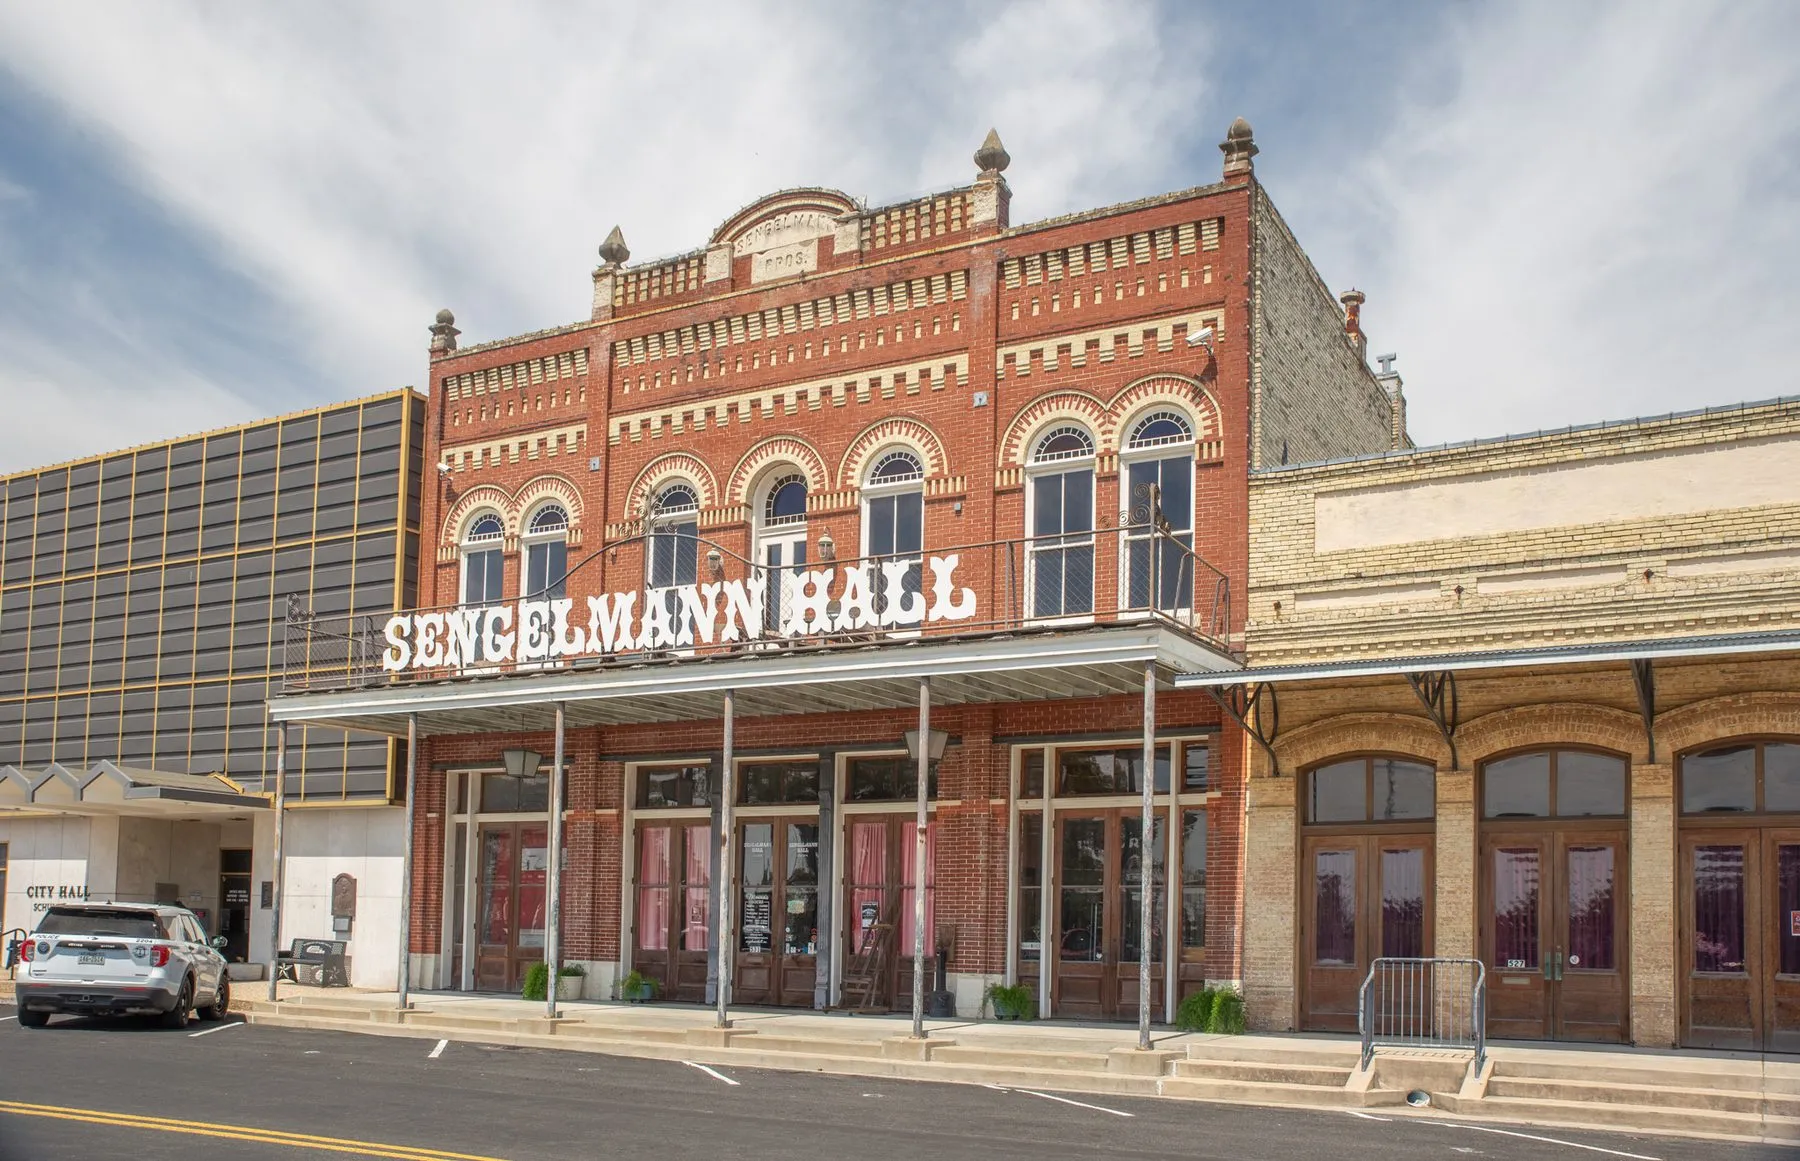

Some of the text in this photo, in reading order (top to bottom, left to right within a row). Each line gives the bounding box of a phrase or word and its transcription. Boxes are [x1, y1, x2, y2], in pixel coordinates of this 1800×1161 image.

[382, 554, 977, 672] SENGELMANN HALL
[27, 885, 91, 898] CITY HALL
[1508, 960, 1525, 968] 527
